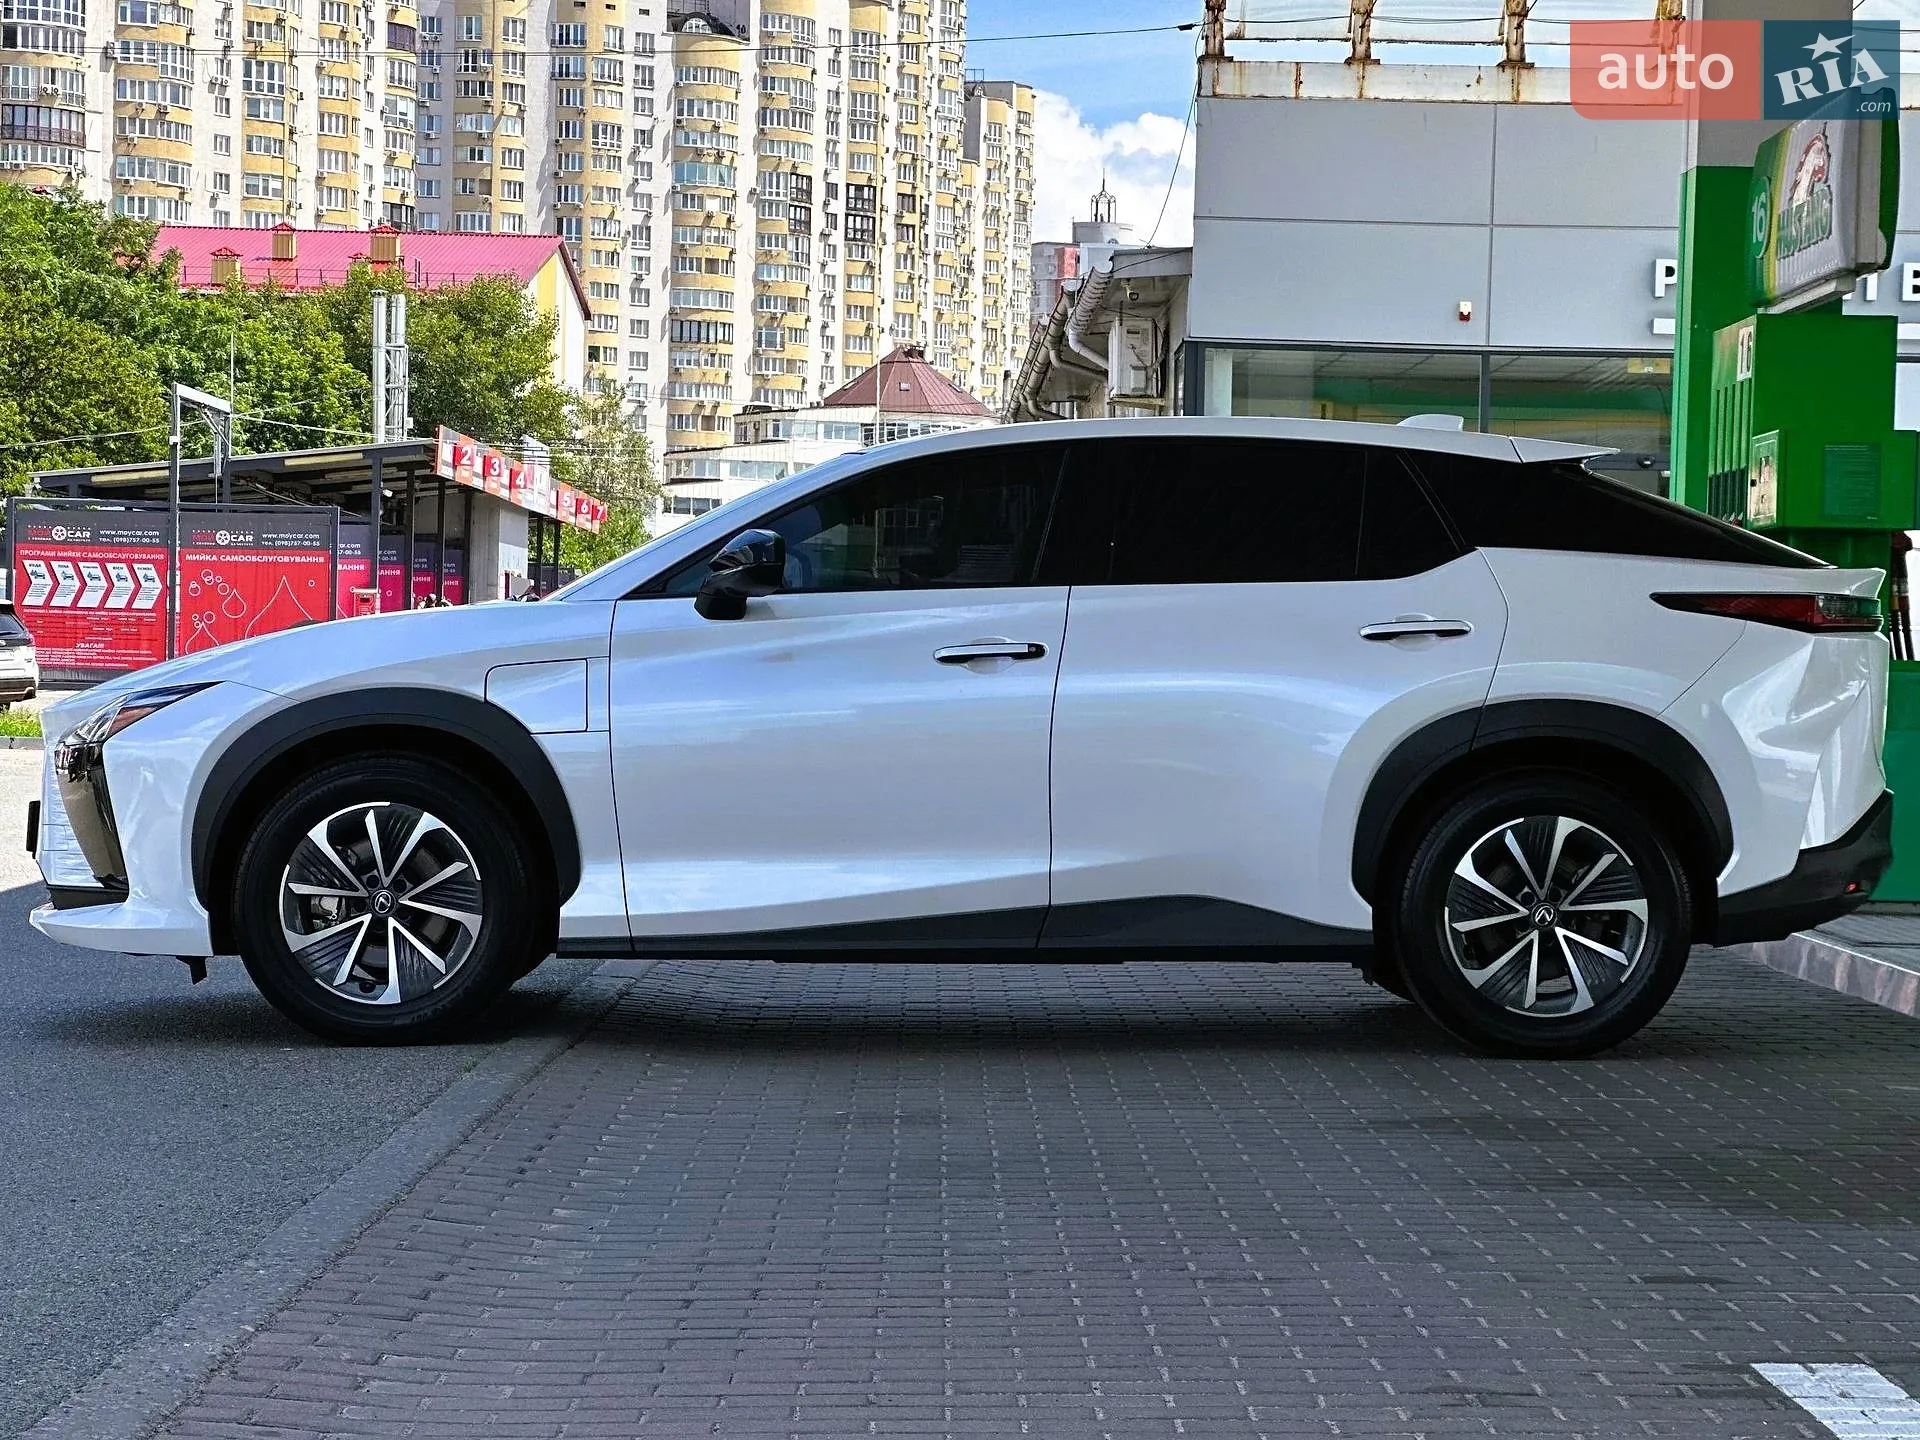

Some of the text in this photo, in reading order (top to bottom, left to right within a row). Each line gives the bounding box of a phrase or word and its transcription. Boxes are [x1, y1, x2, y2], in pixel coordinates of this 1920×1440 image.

[1751, 191, 1767, 244] 16
[461, 445, 605, 519] 2 3 4 5 6 7
[67, 530, 91, 538] CAR
[230, 534, 254, 542] CAR
[185, 553, 325, 563] МИЙКА САМООБСЛУГОВУВАННЯ
